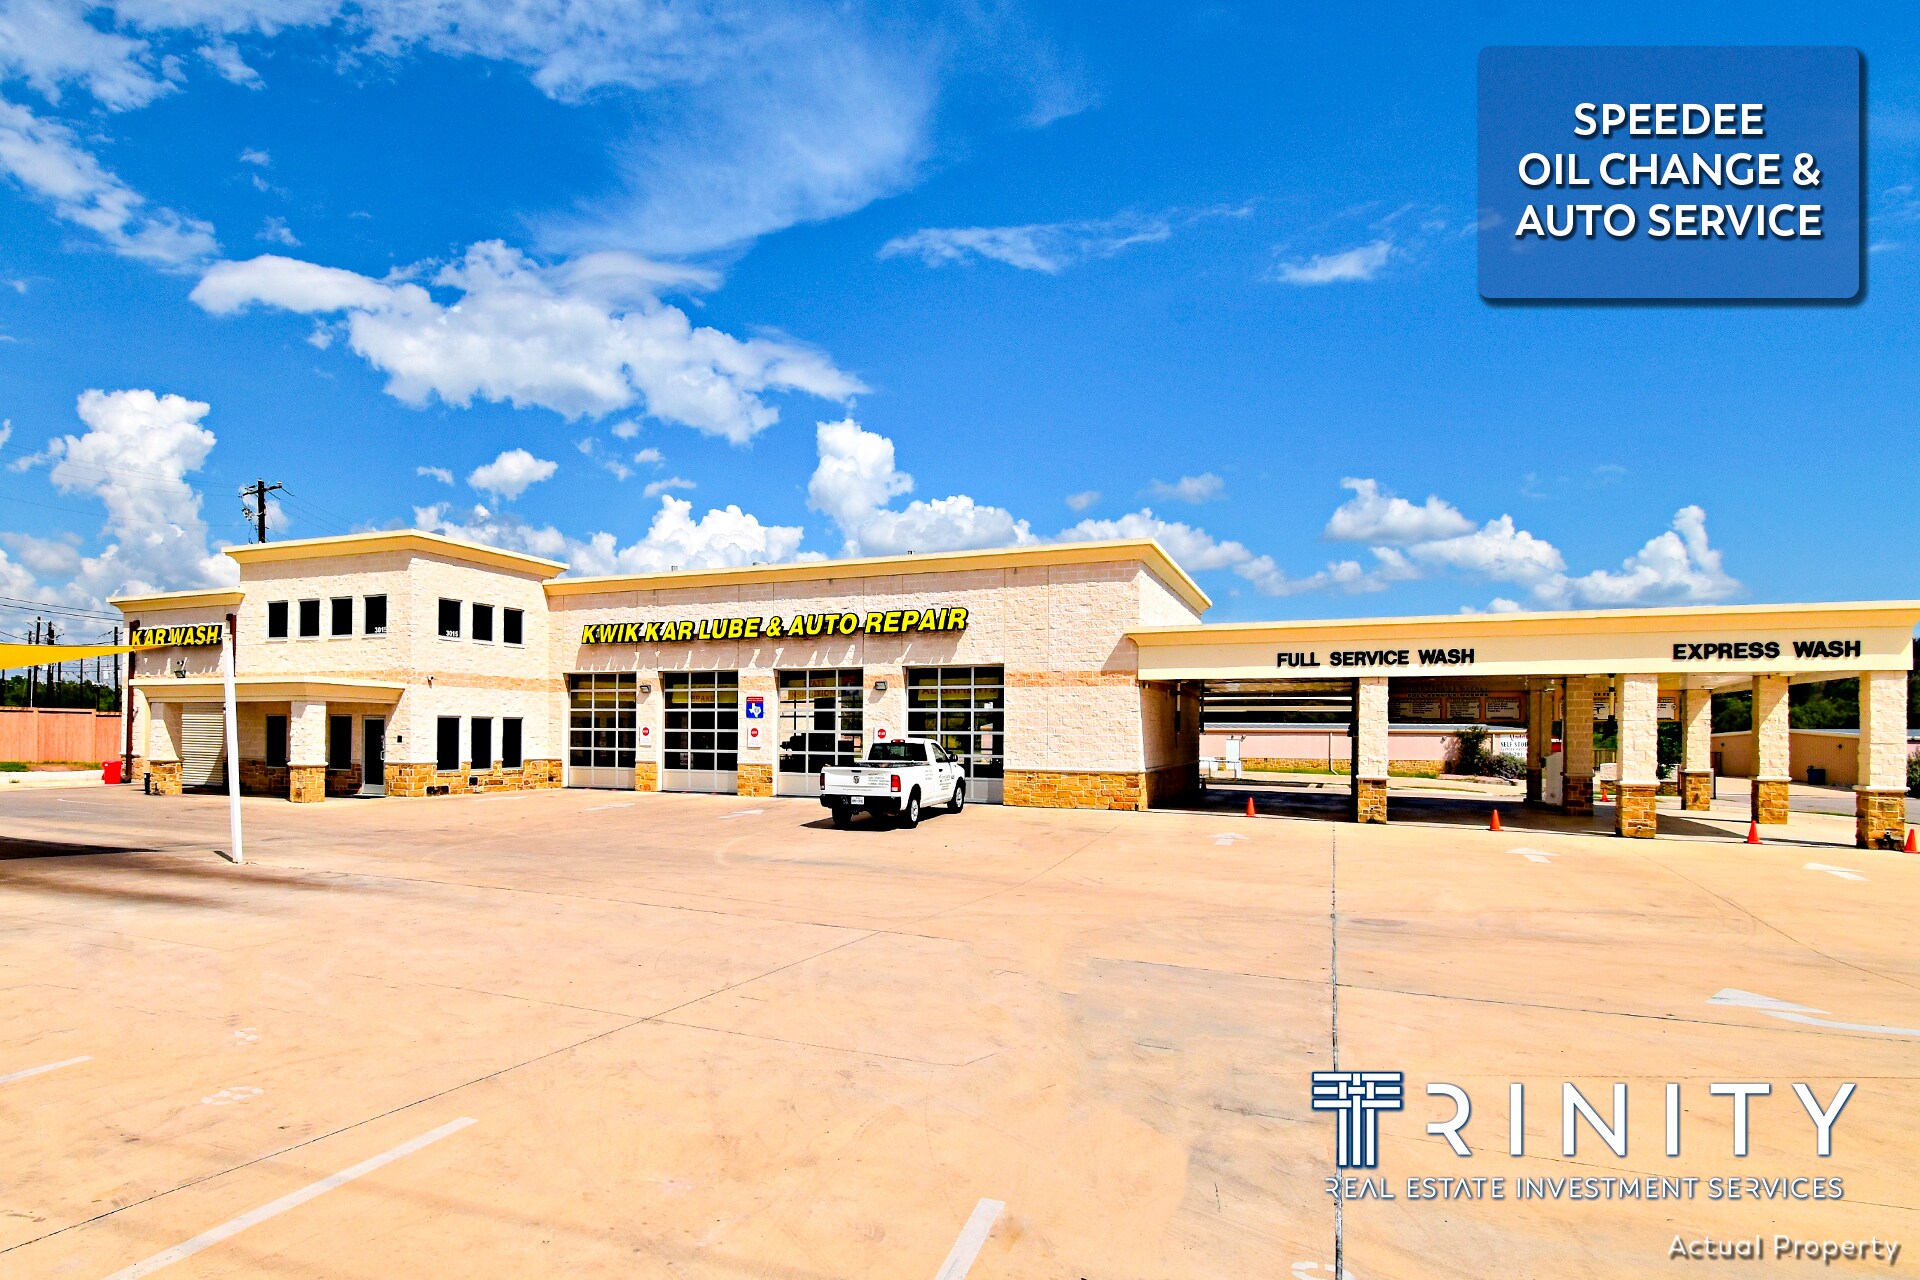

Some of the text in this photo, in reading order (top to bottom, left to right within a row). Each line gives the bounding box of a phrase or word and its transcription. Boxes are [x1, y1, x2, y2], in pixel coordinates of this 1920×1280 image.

[581, 606, 969, 645] KWIK KAR LUBE & AUTO REPAIR
[131, 624, 221, 647] KAR WASH
[1277, 648, 1475, 667] FULL SERVICE WASH
[1672, 640, 1861, 660] EXPRESS WASH
[803, 679, 827, 687] SATE
[788, 690, 837, 699] INSPCTION
